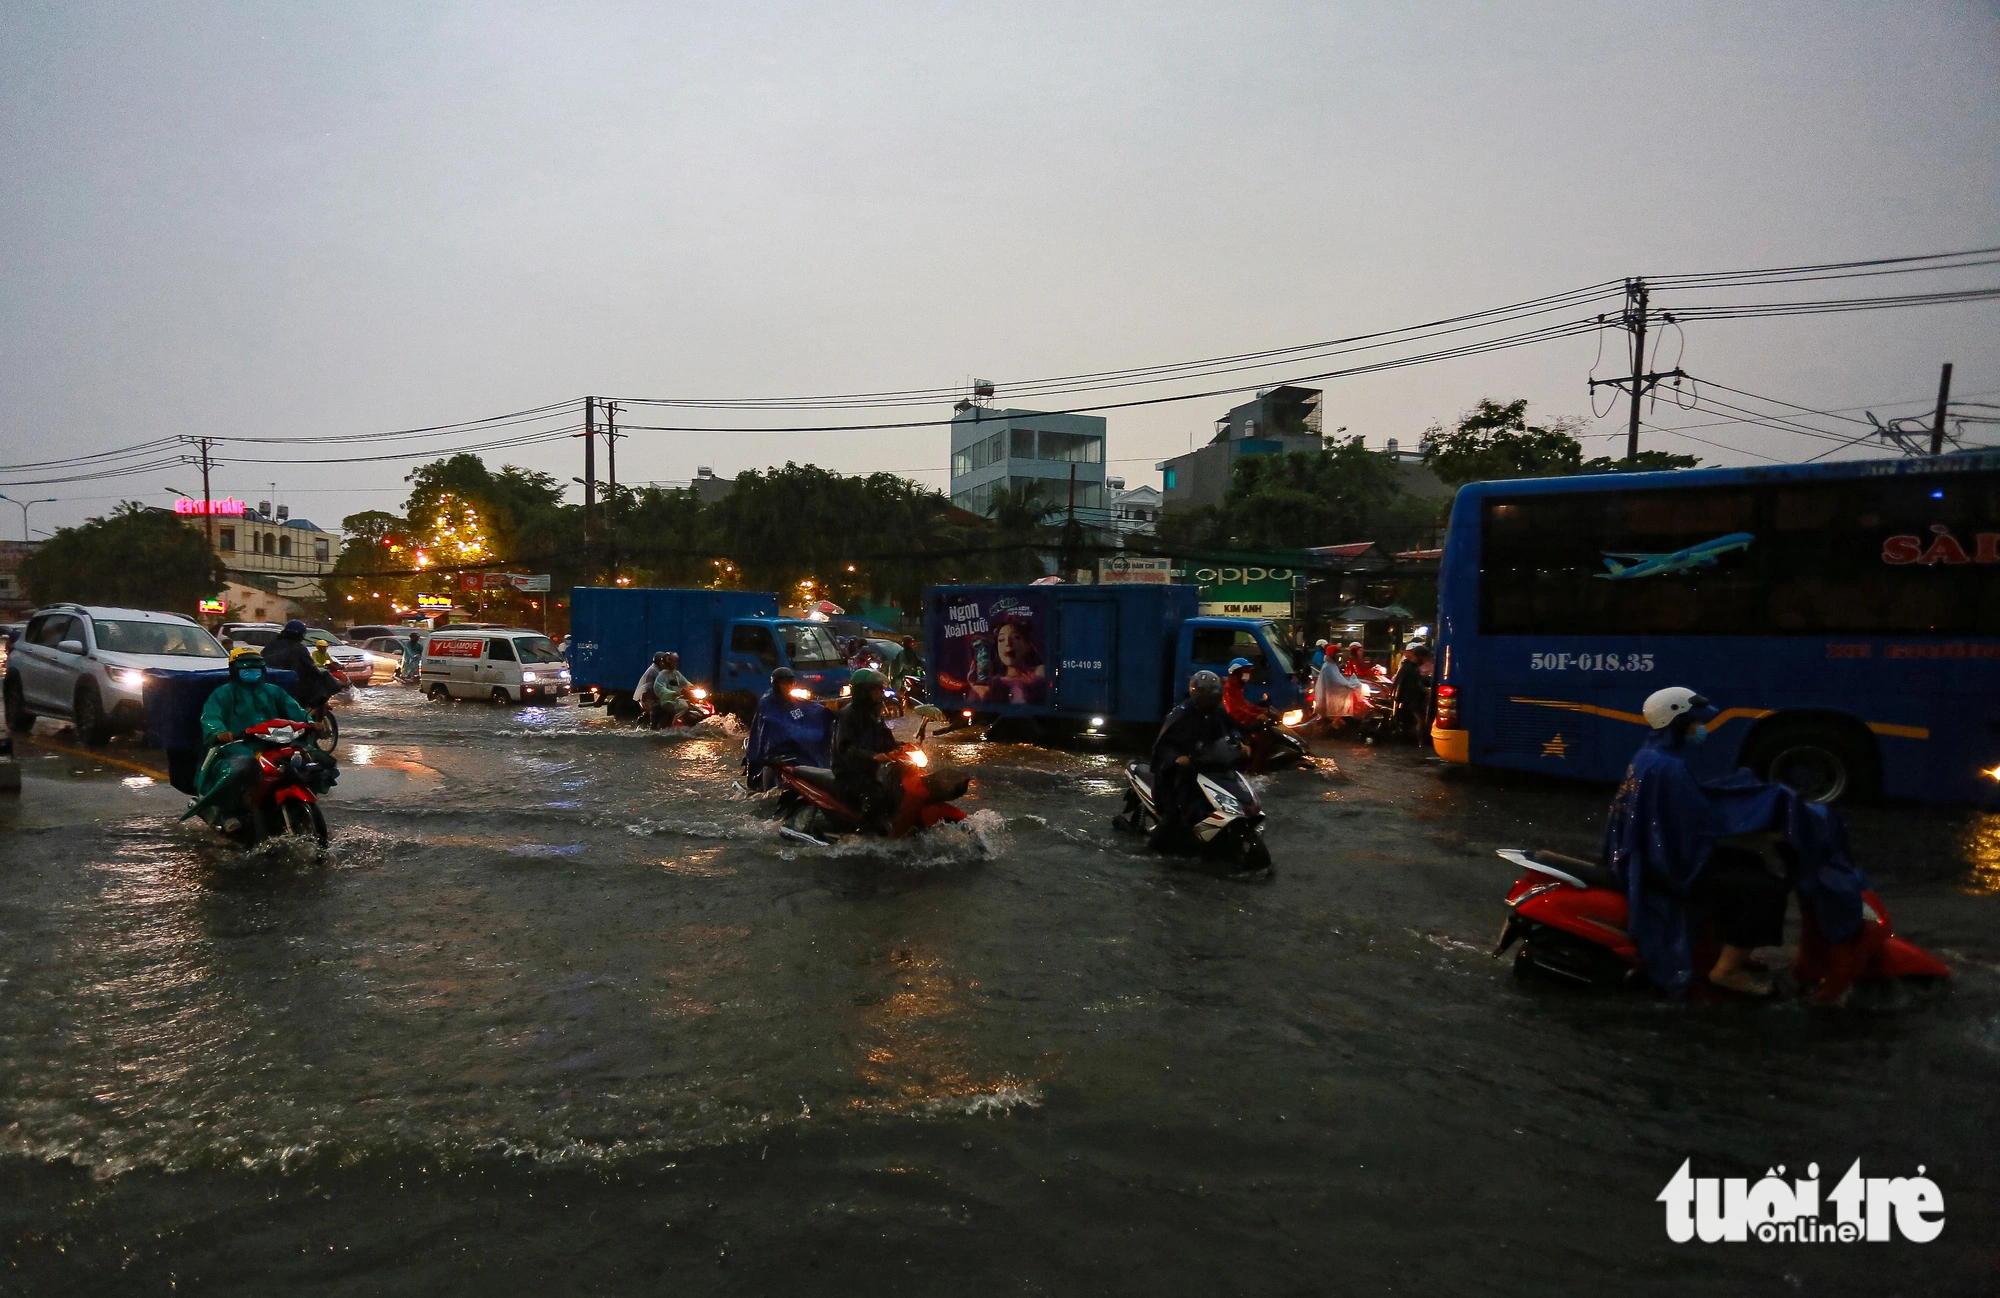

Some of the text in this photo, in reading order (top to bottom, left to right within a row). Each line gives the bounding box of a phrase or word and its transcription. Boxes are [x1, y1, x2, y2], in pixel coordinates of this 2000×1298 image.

[949, 603, 980, 622] Ngon
[1224, 604, 1262, 613] KIM ANH
[1530, 652, 1655, 672] 50F-018.35
